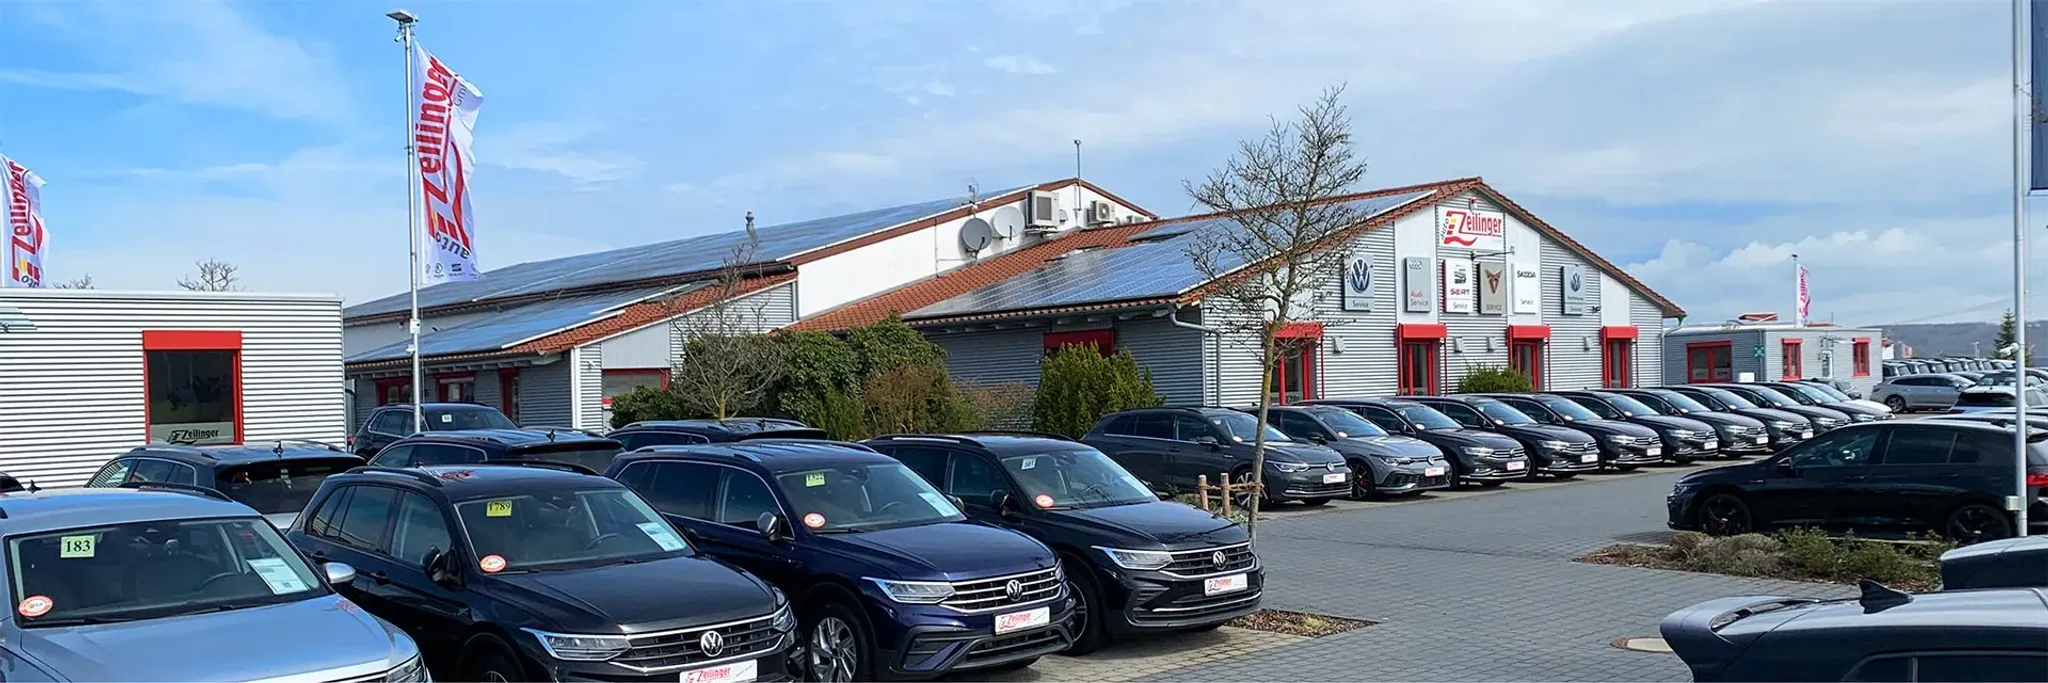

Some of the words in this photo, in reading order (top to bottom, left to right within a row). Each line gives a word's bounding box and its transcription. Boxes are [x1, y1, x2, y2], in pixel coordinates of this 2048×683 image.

[416, 56, 456, 238] Zeilinger
[1446, 211, 1502, 237] Zeilinger
[170, 429, 219, 440] Zeilinger
[66, 540, 91, 552] 183
